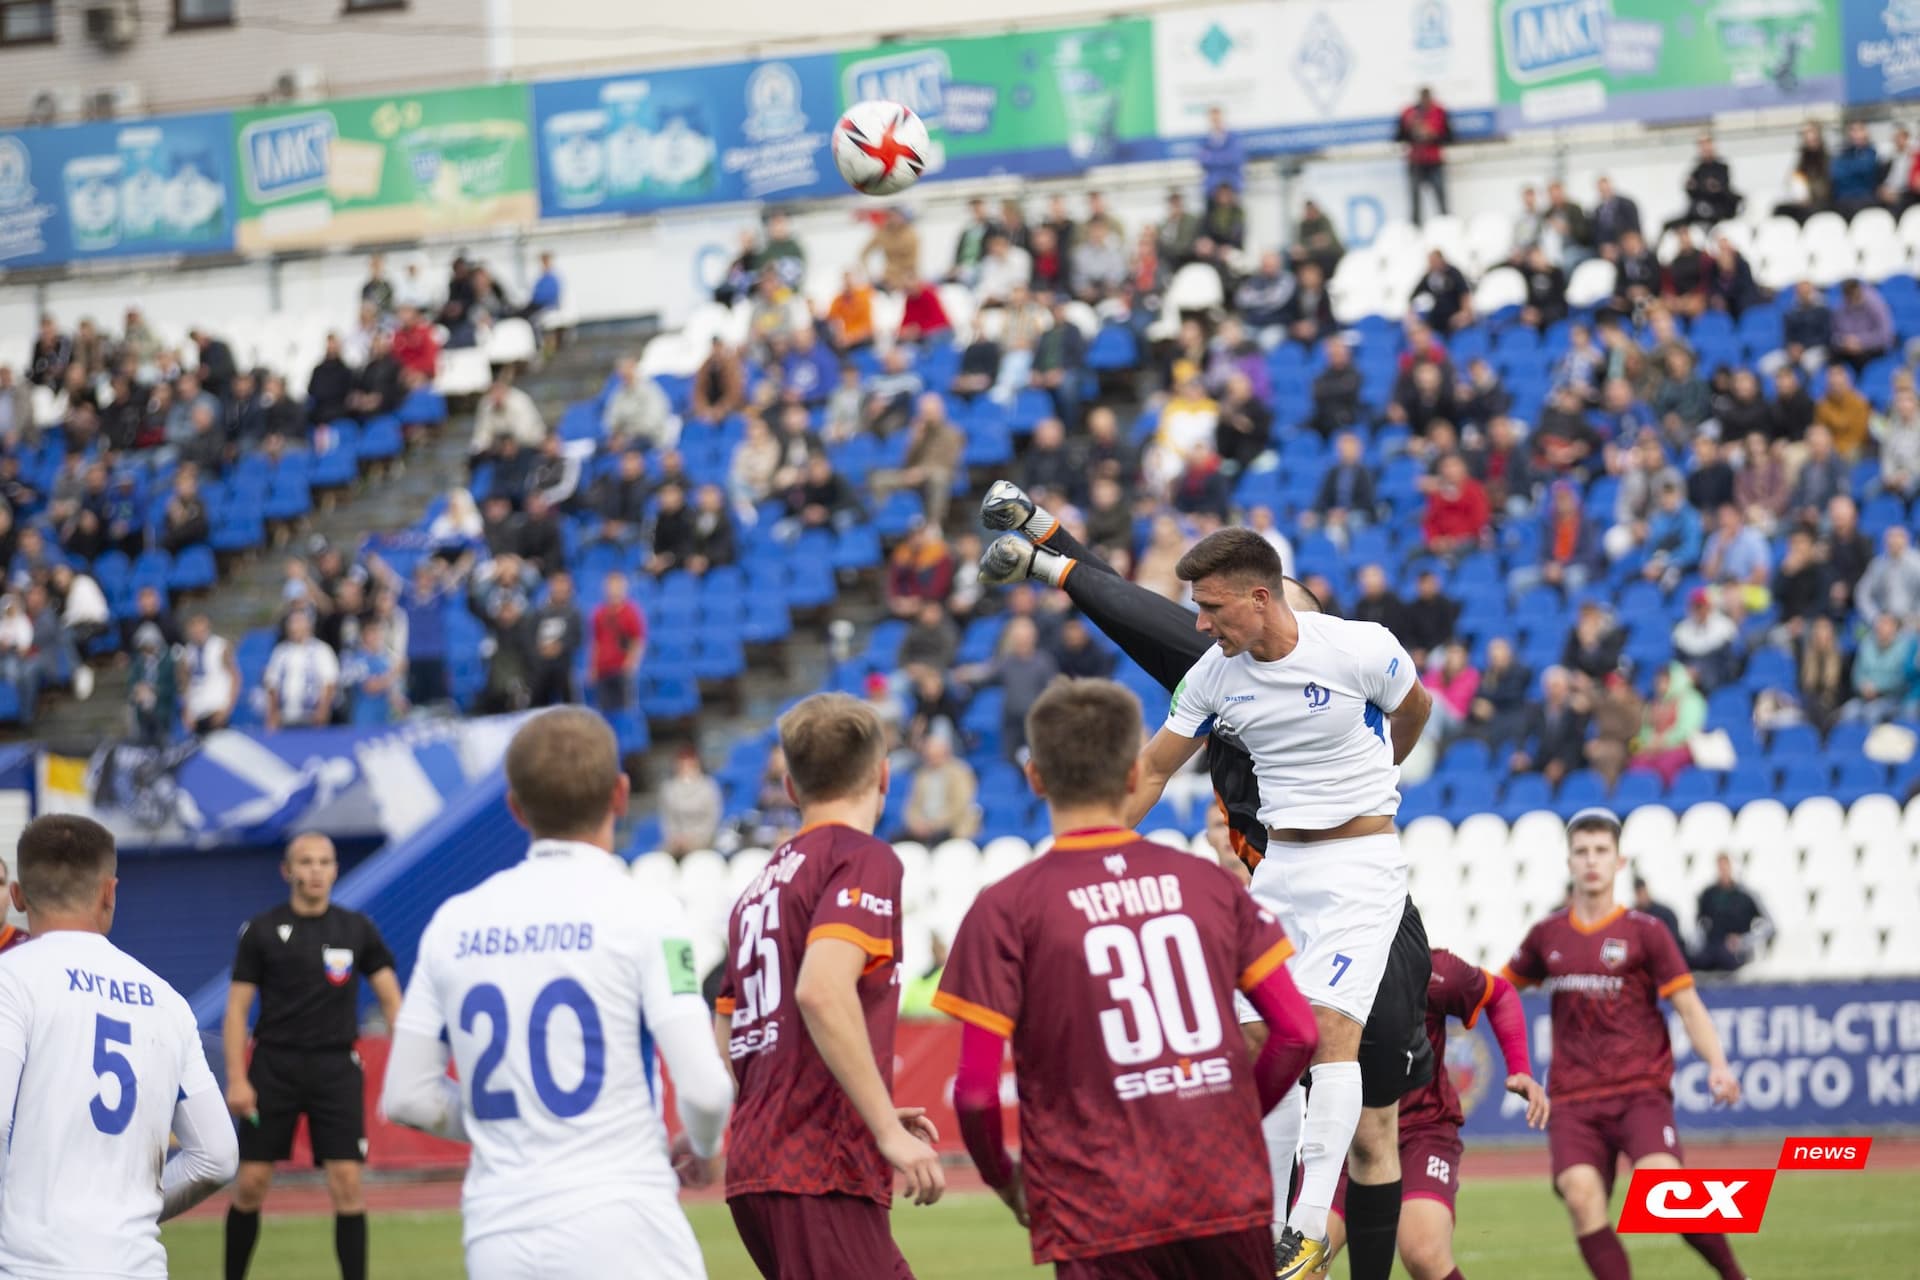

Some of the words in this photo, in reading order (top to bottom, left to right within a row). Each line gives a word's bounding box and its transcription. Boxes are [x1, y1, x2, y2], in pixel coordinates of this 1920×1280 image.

[1067, 874, 1183, 924] ЧЕРНОВ
[454, 921, 594, 960] ЗАВЬЯЛОВ
[66, 968, 155, 1006] ХУГАЕВ
[1084, 913, 1223, 1066] 30
[1328, 953, 1353, 987] 7
[460, 977, 605, 1121] 20
[89, 1012, 137, 1136] 5
[1113, 1057, 1232, 1101] SEUS
[1426, 1154, 1450, 1185] 22
